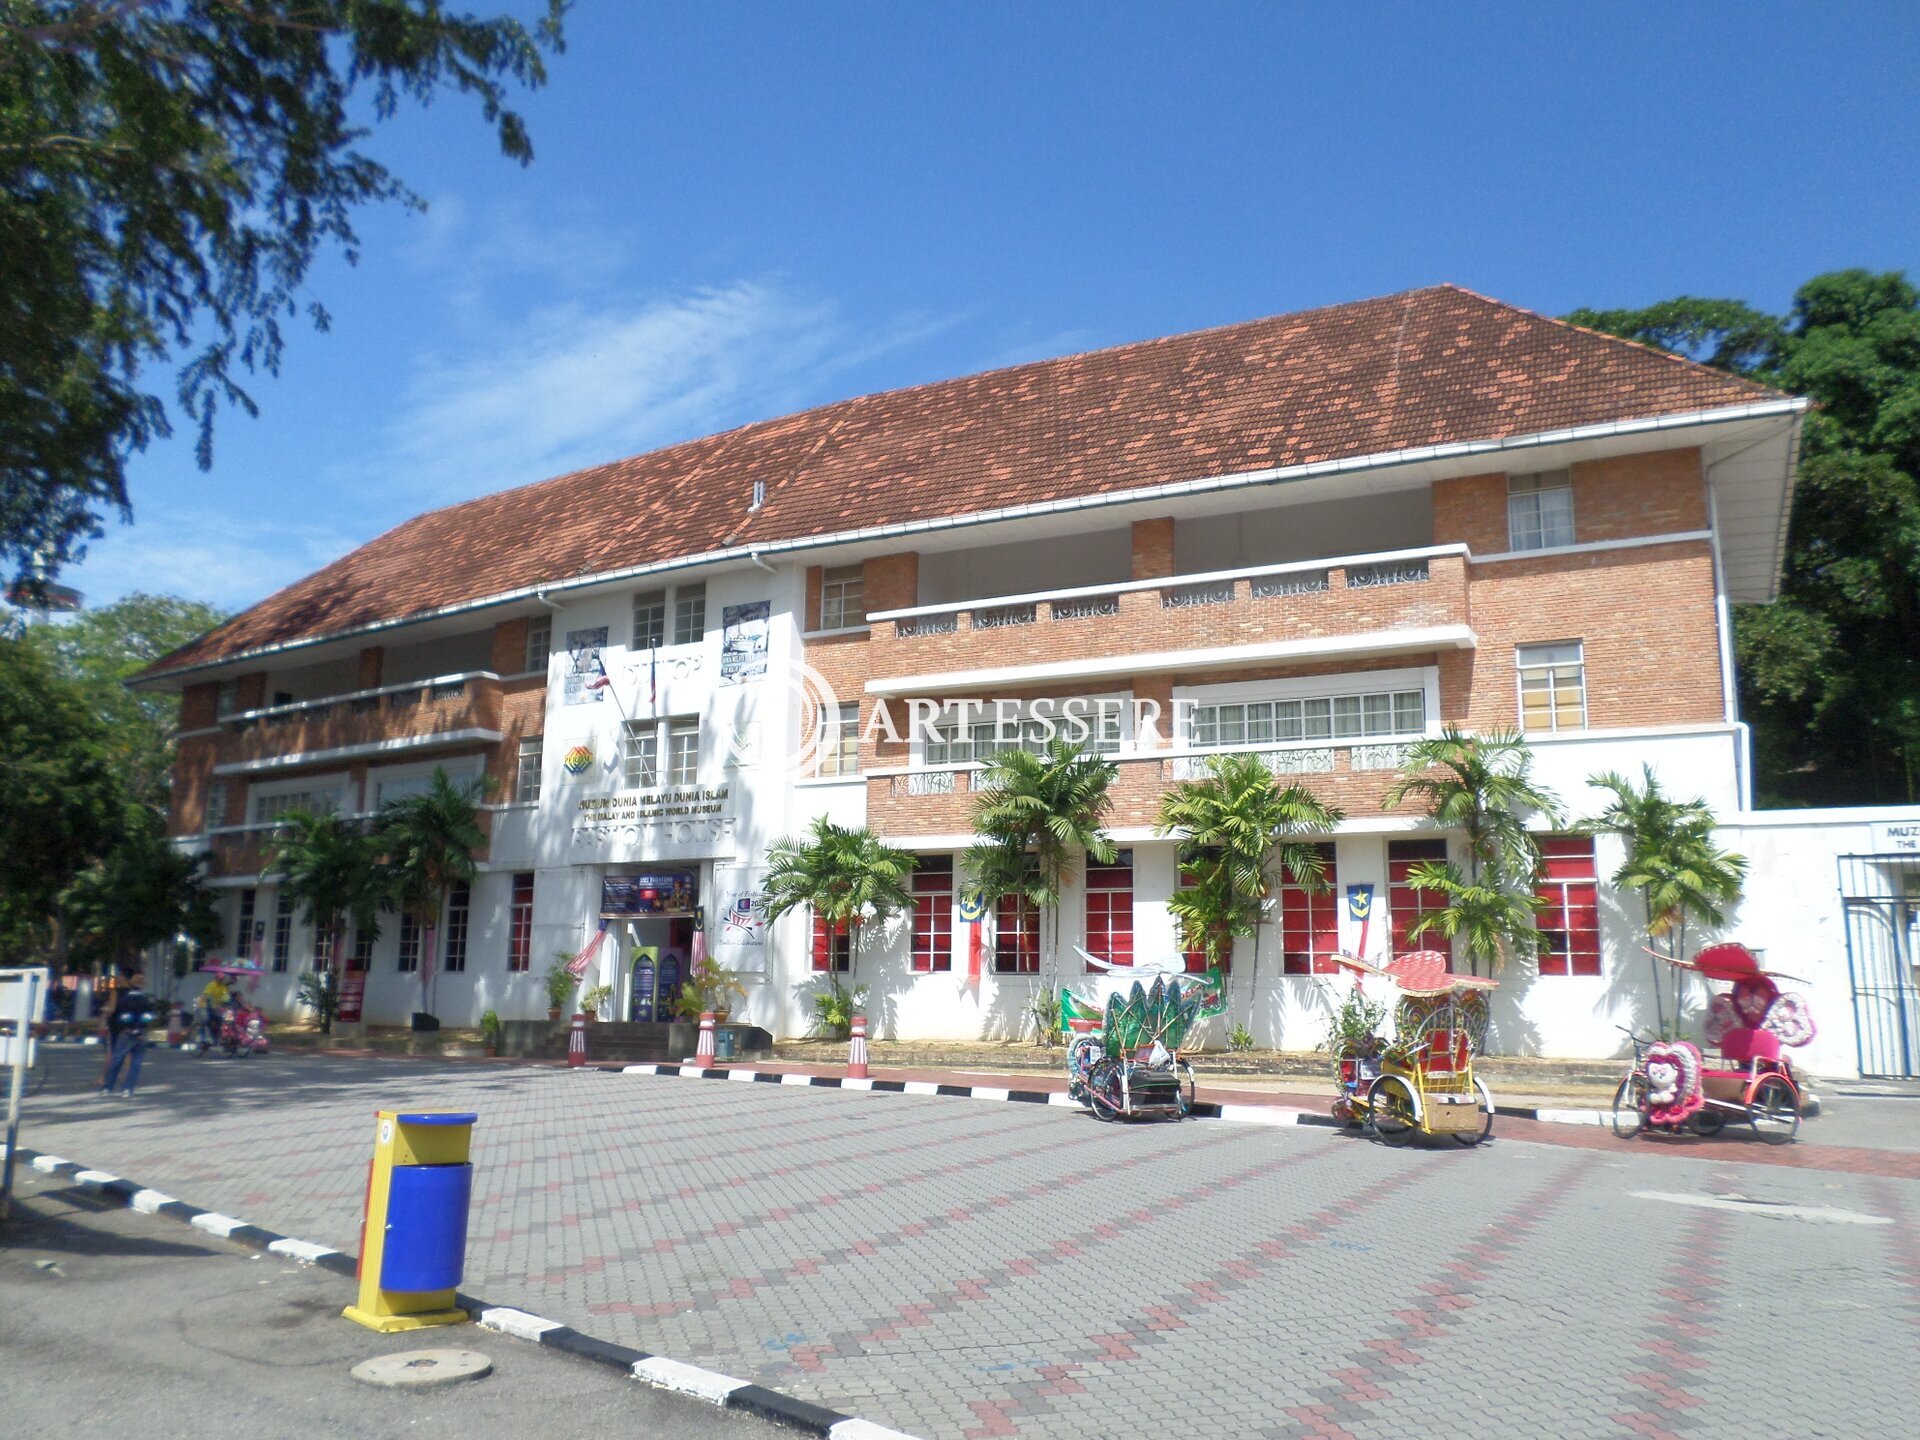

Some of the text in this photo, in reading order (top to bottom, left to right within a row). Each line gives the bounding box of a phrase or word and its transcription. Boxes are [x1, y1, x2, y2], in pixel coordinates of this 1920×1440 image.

[578, 788, 729, 810] MUZIUM DUNIA MELAYU DUNIA ISLAM
[584, 803, 722, 822] THE MALAY AND ISLAMIC WORLD MUSEUM
[1887, 826, 1920, 837] MUZ
[1896, 840, 1916, 849] THE
